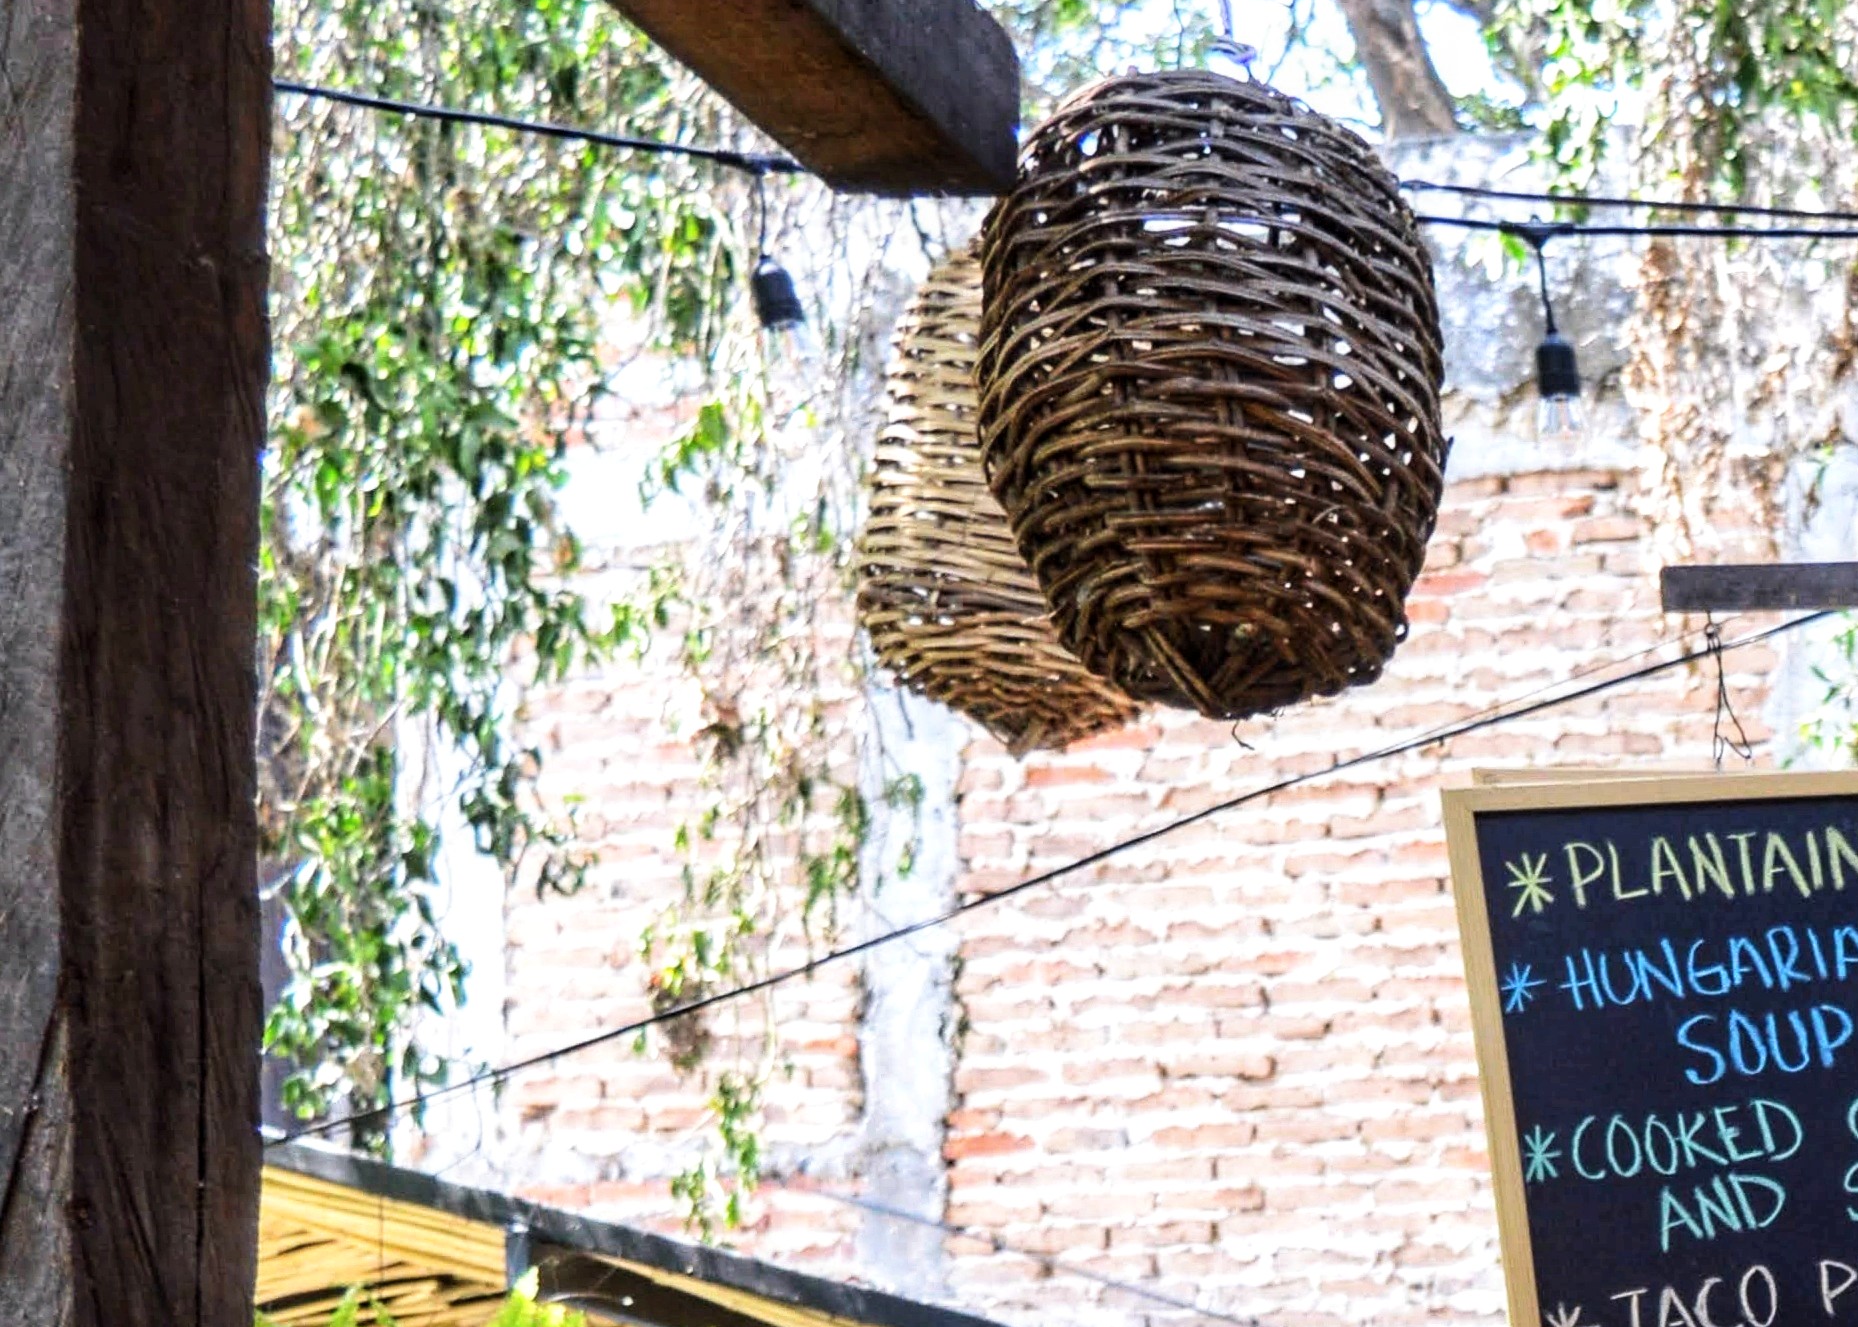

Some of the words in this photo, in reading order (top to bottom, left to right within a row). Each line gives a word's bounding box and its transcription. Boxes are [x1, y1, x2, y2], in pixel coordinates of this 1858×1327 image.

[1676, 1002, 1856, 1086] SOUP
[1571, 1098, 1804, 1180] COOKED
[1658, 1171, 1787, 1253] AND
